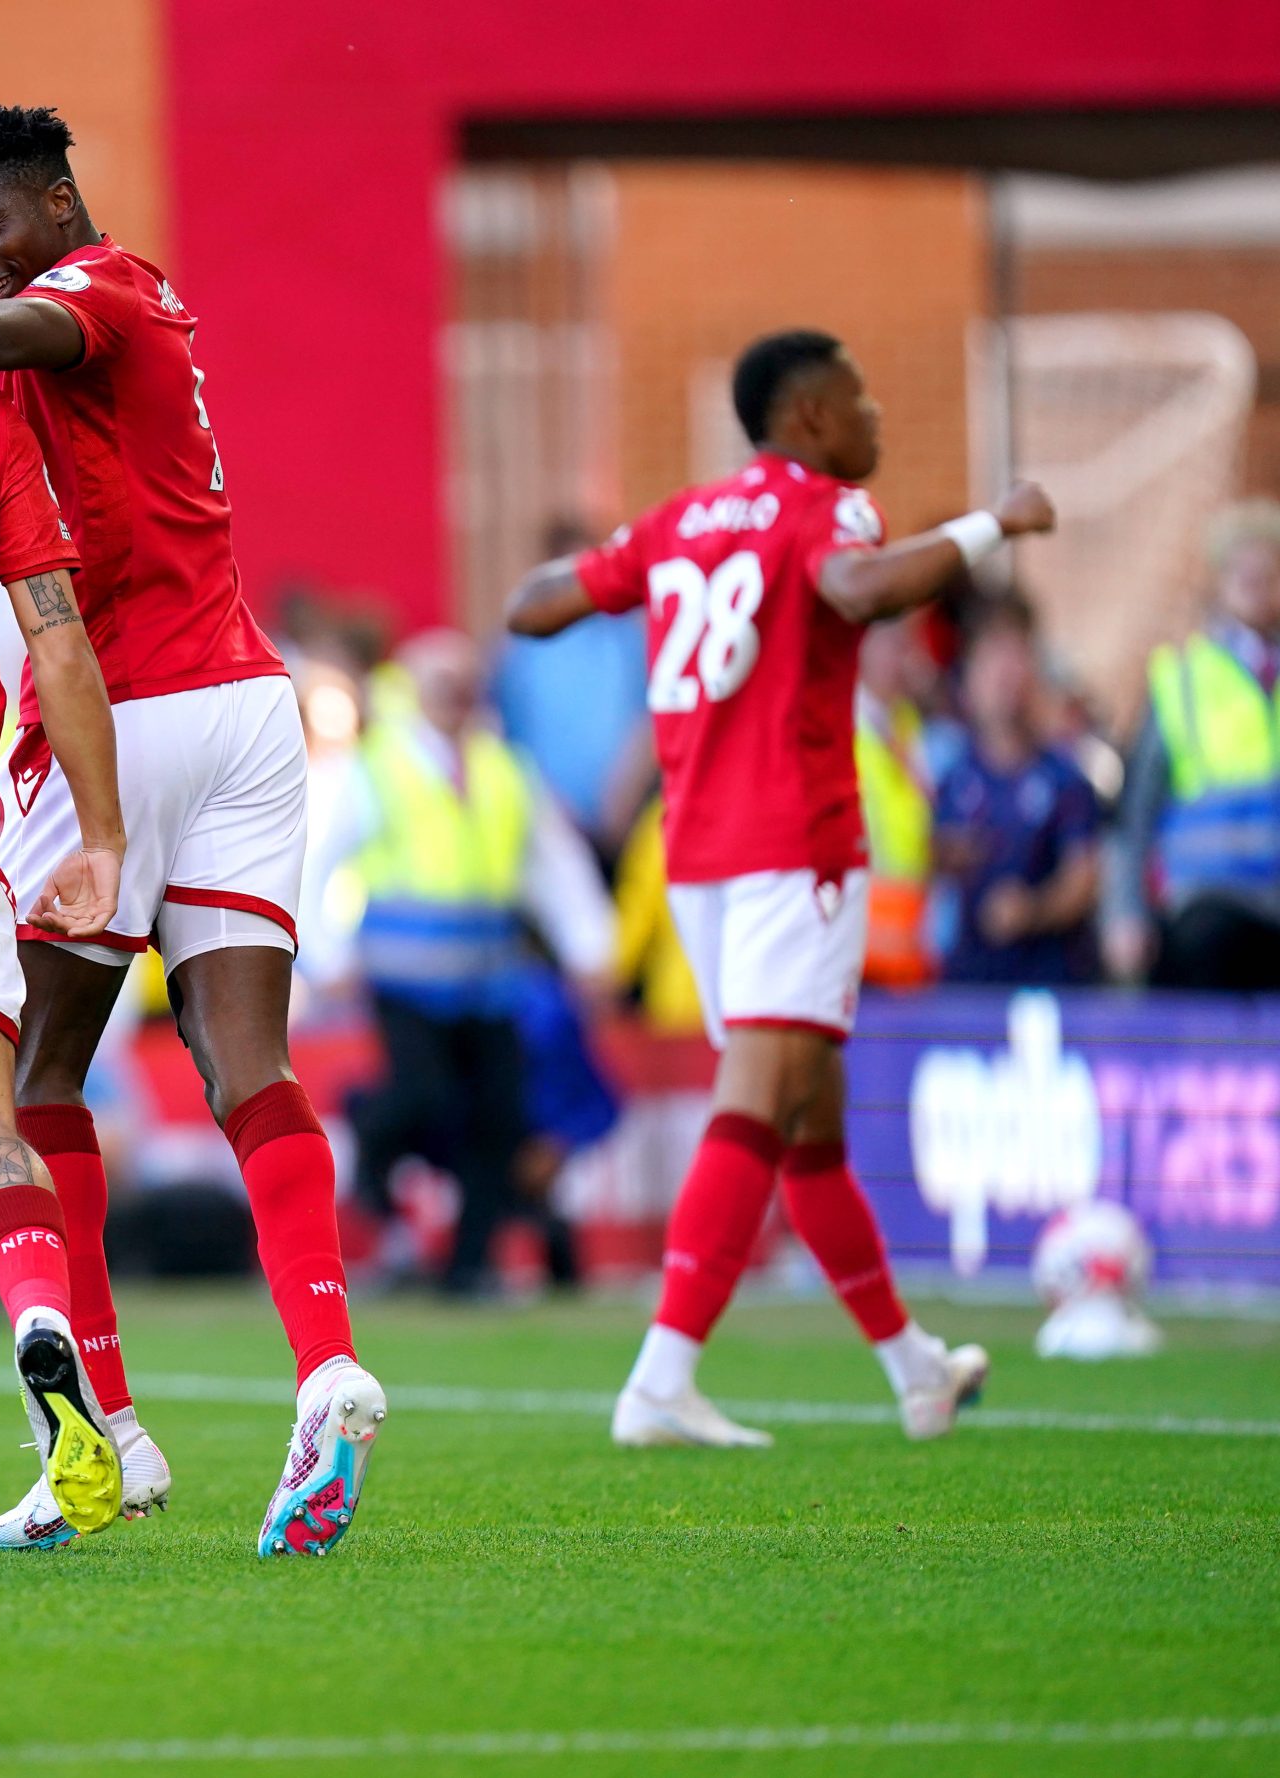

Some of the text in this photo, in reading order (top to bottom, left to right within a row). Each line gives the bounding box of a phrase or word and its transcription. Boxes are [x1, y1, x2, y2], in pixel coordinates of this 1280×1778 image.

[45, 618, 58, 629] the
[646, 549, 764, 714] 28
[1, 1230, 59, 1255] NFFC
[309, 1280, 349, 1308] NFF
[82, 1334, 121, 1353] NFF
